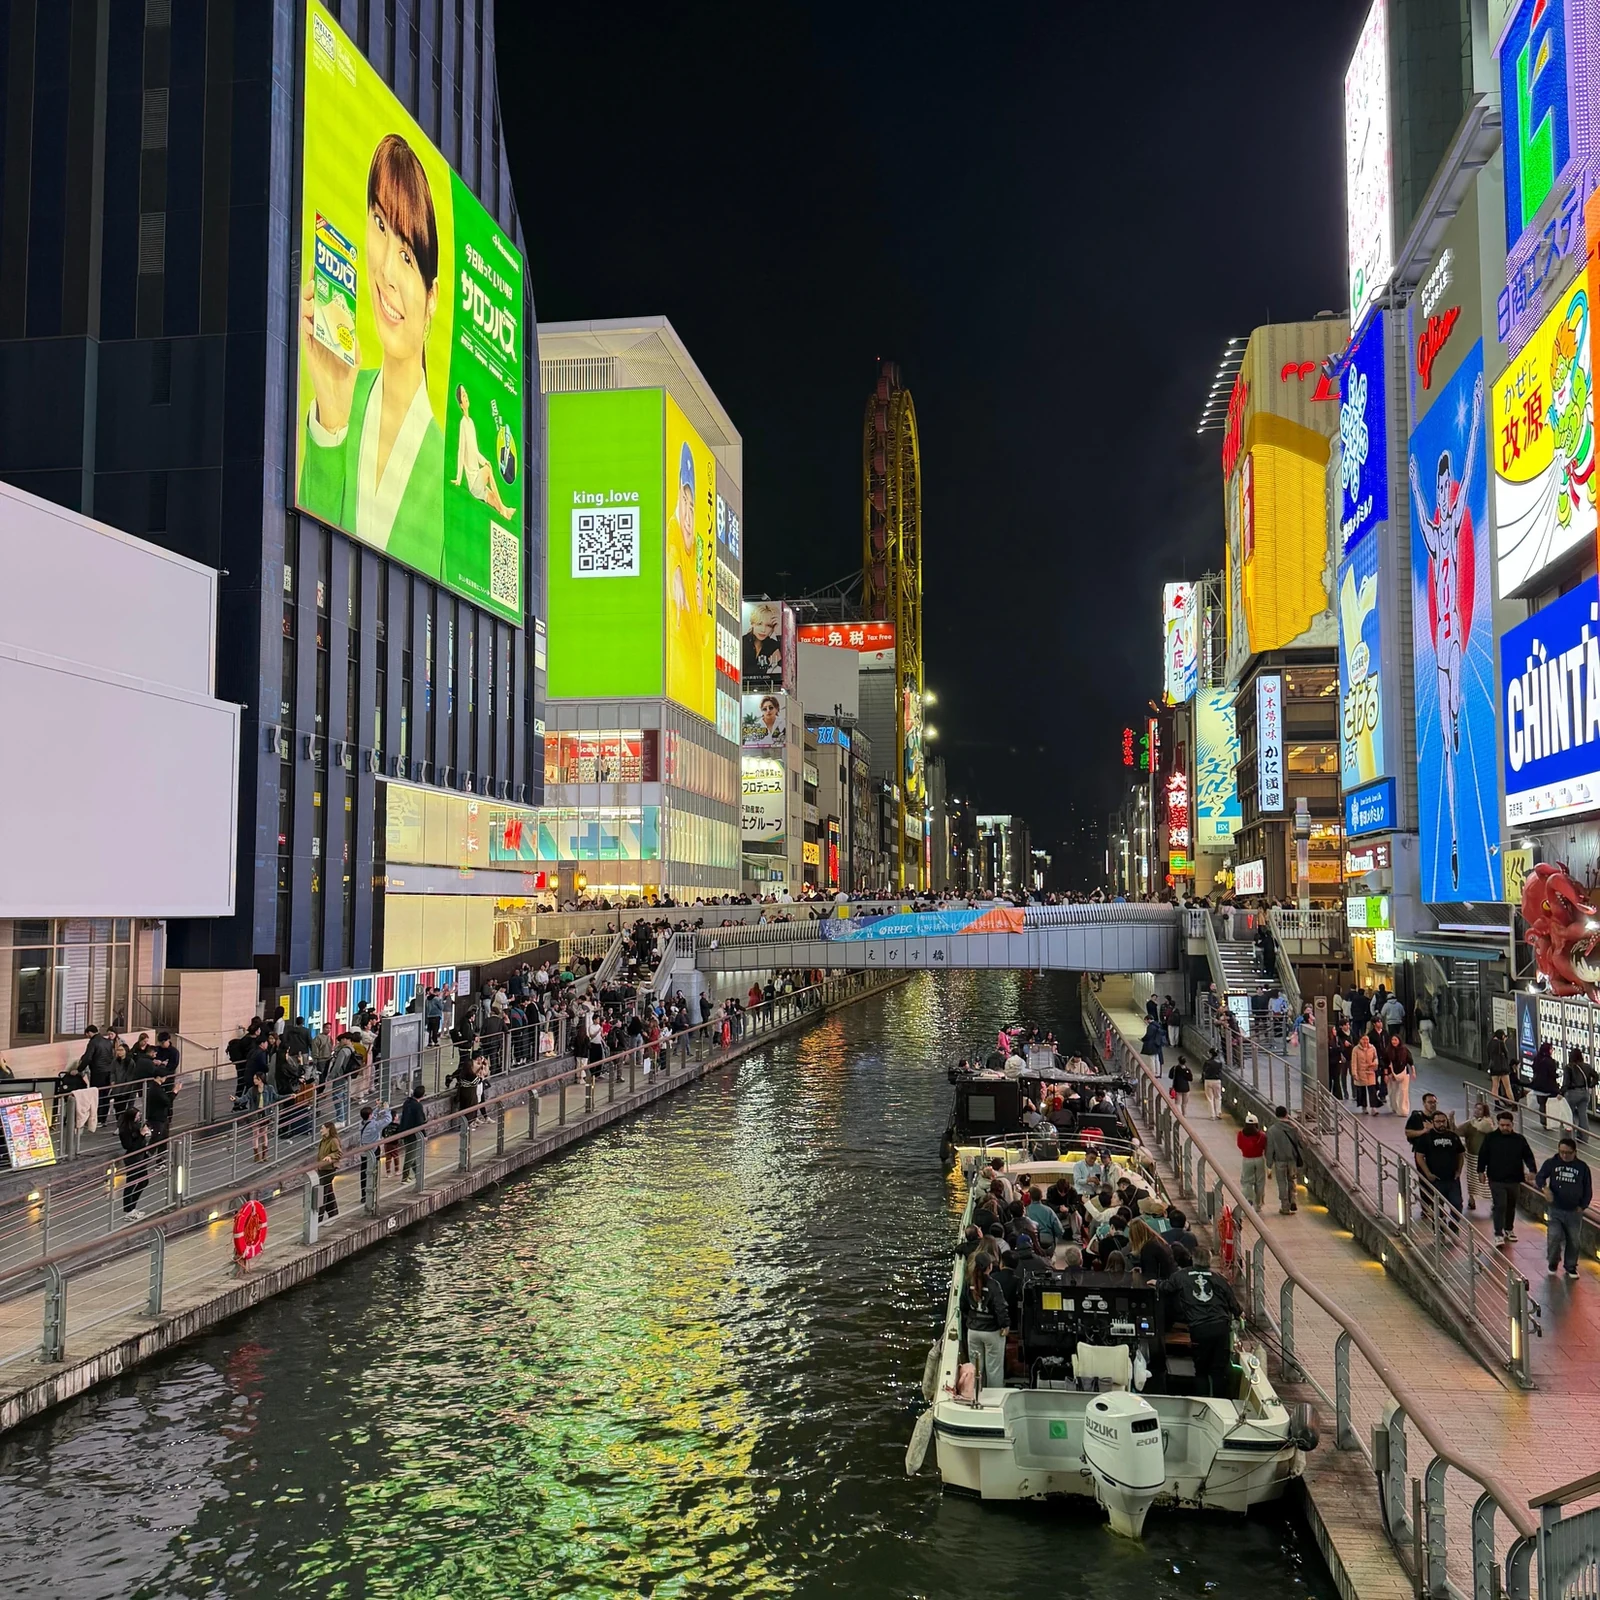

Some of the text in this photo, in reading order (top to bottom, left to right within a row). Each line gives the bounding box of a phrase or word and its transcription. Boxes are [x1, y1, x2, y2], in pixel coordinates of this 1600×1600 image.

[317, 241, 356, 294] サロンパス
[461, 269, 517, 363] サロンパス
[1504, 356, 1538, 415] かぜに
[1501, 382, 1543, 473] 改源
[573, 489, 639, 506] king.love
[1441, 550, 1451, 639] グリコ
[828, 631, 865, 647] 免税
[1264, 697, 1277, 740] 本場の味
[1343, 671, 1379, 742] さける
[1264, 745, 1280, 806] かに道楽
[1344, 741, 1358, 773] チーズ
[867, 949, 944, 962] えびす橋
[1085, 1416, 1118, 1440] SUZUKI
[1136, 1437, 1159, 1446] 200
